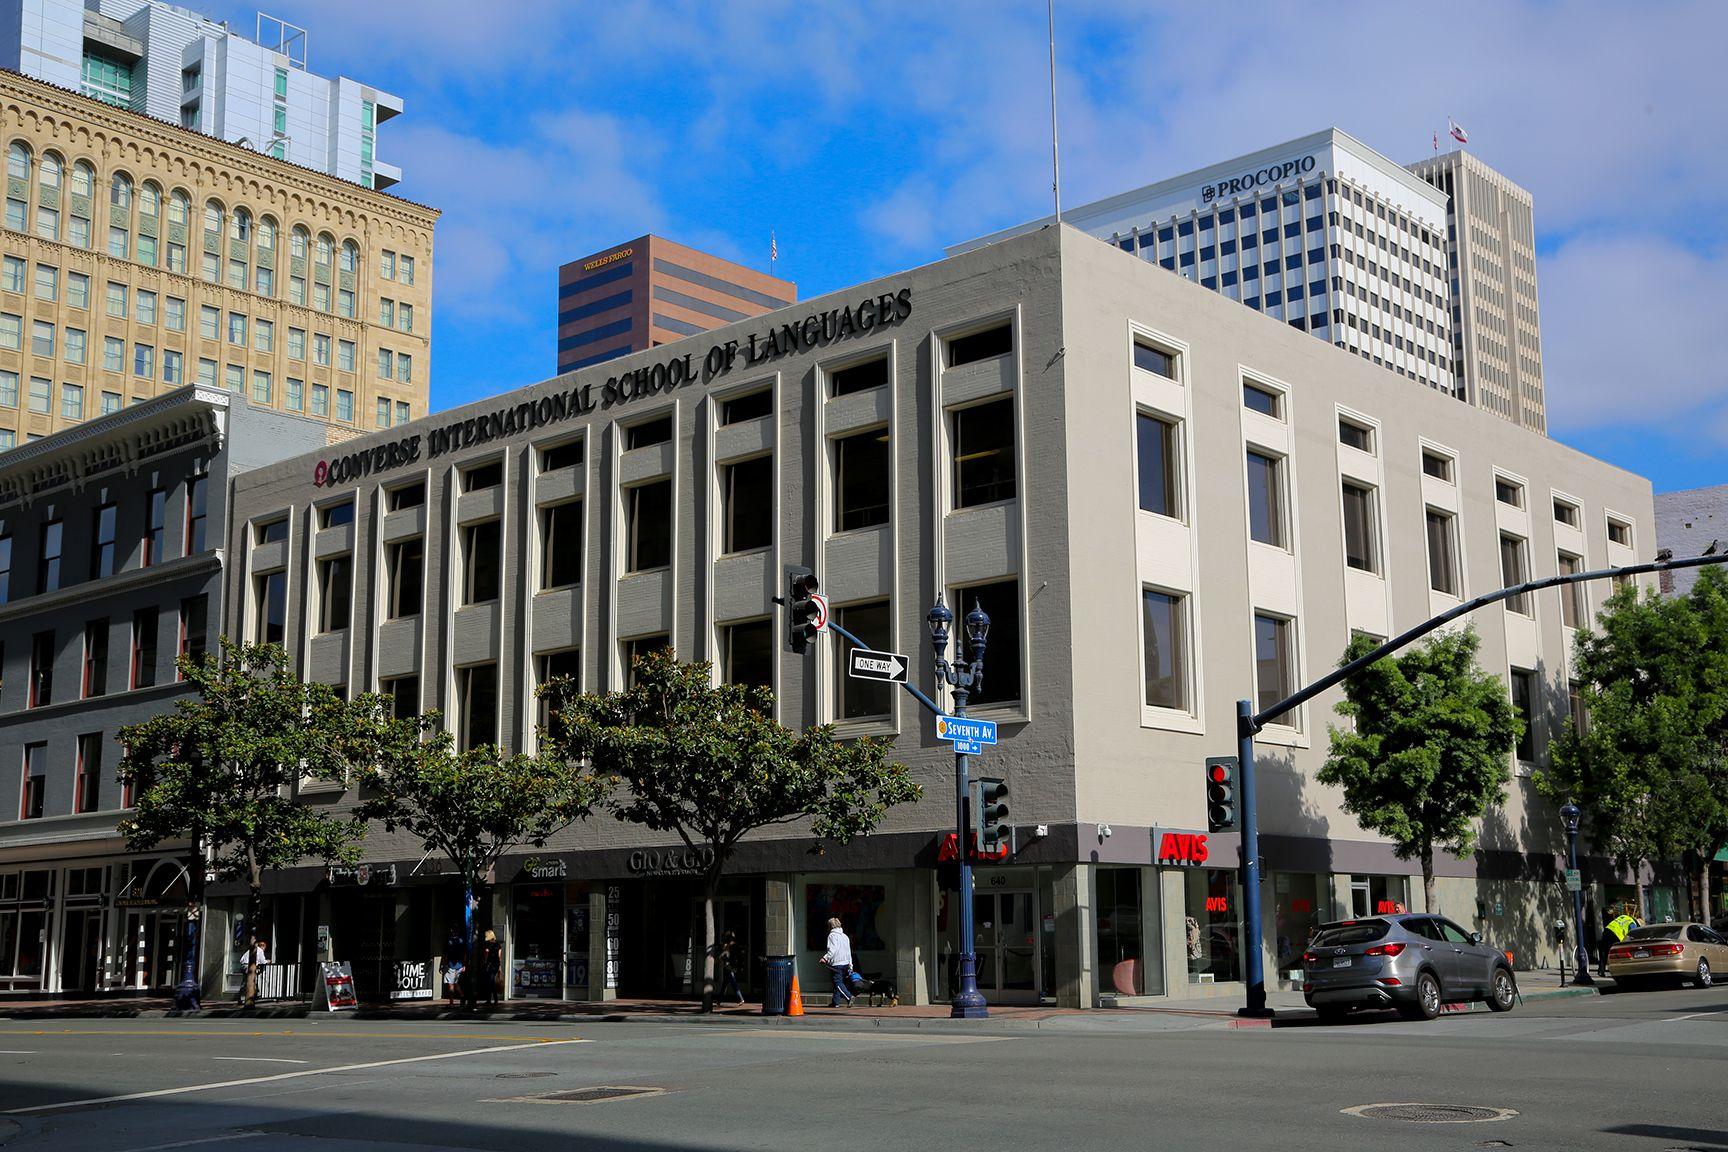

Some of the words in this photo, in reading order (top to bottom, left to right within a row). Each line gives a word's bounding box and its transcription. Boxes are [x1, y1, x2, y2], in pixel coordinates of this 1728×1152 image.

[1218, 156, 1315, 197] PROCOPIO
[584, 257, 608, 270] WELLS
[609, 249, 633, 263] FARGO
[327, 434, 421, 487] CONVERSE
[427, 383, 597, 459] INTERNATIONAL
[601, 353, 698, 410] SCHOOL
[705, 339, 738, 377] OF
[746, 287, 911, 366] LANGUAGES
[859, 659, 874, 670] ONE
[876, 661, 891, 672] WAY
[1158, 833, 1208, 862] AVIS
[630, 850, 662, 871] GIO
[664, 849, 681, 869] &
[991, 876, 1006, 886] 640
[608, 886, 620, 899] 25
[1205, 897, 1227, 912] AVIS
[608, 913, 619, 926] 50
[401, 961, 425, 977] TIME
[607, 960, 619, 974] 80
[402, 976, 424, 989] OUT
